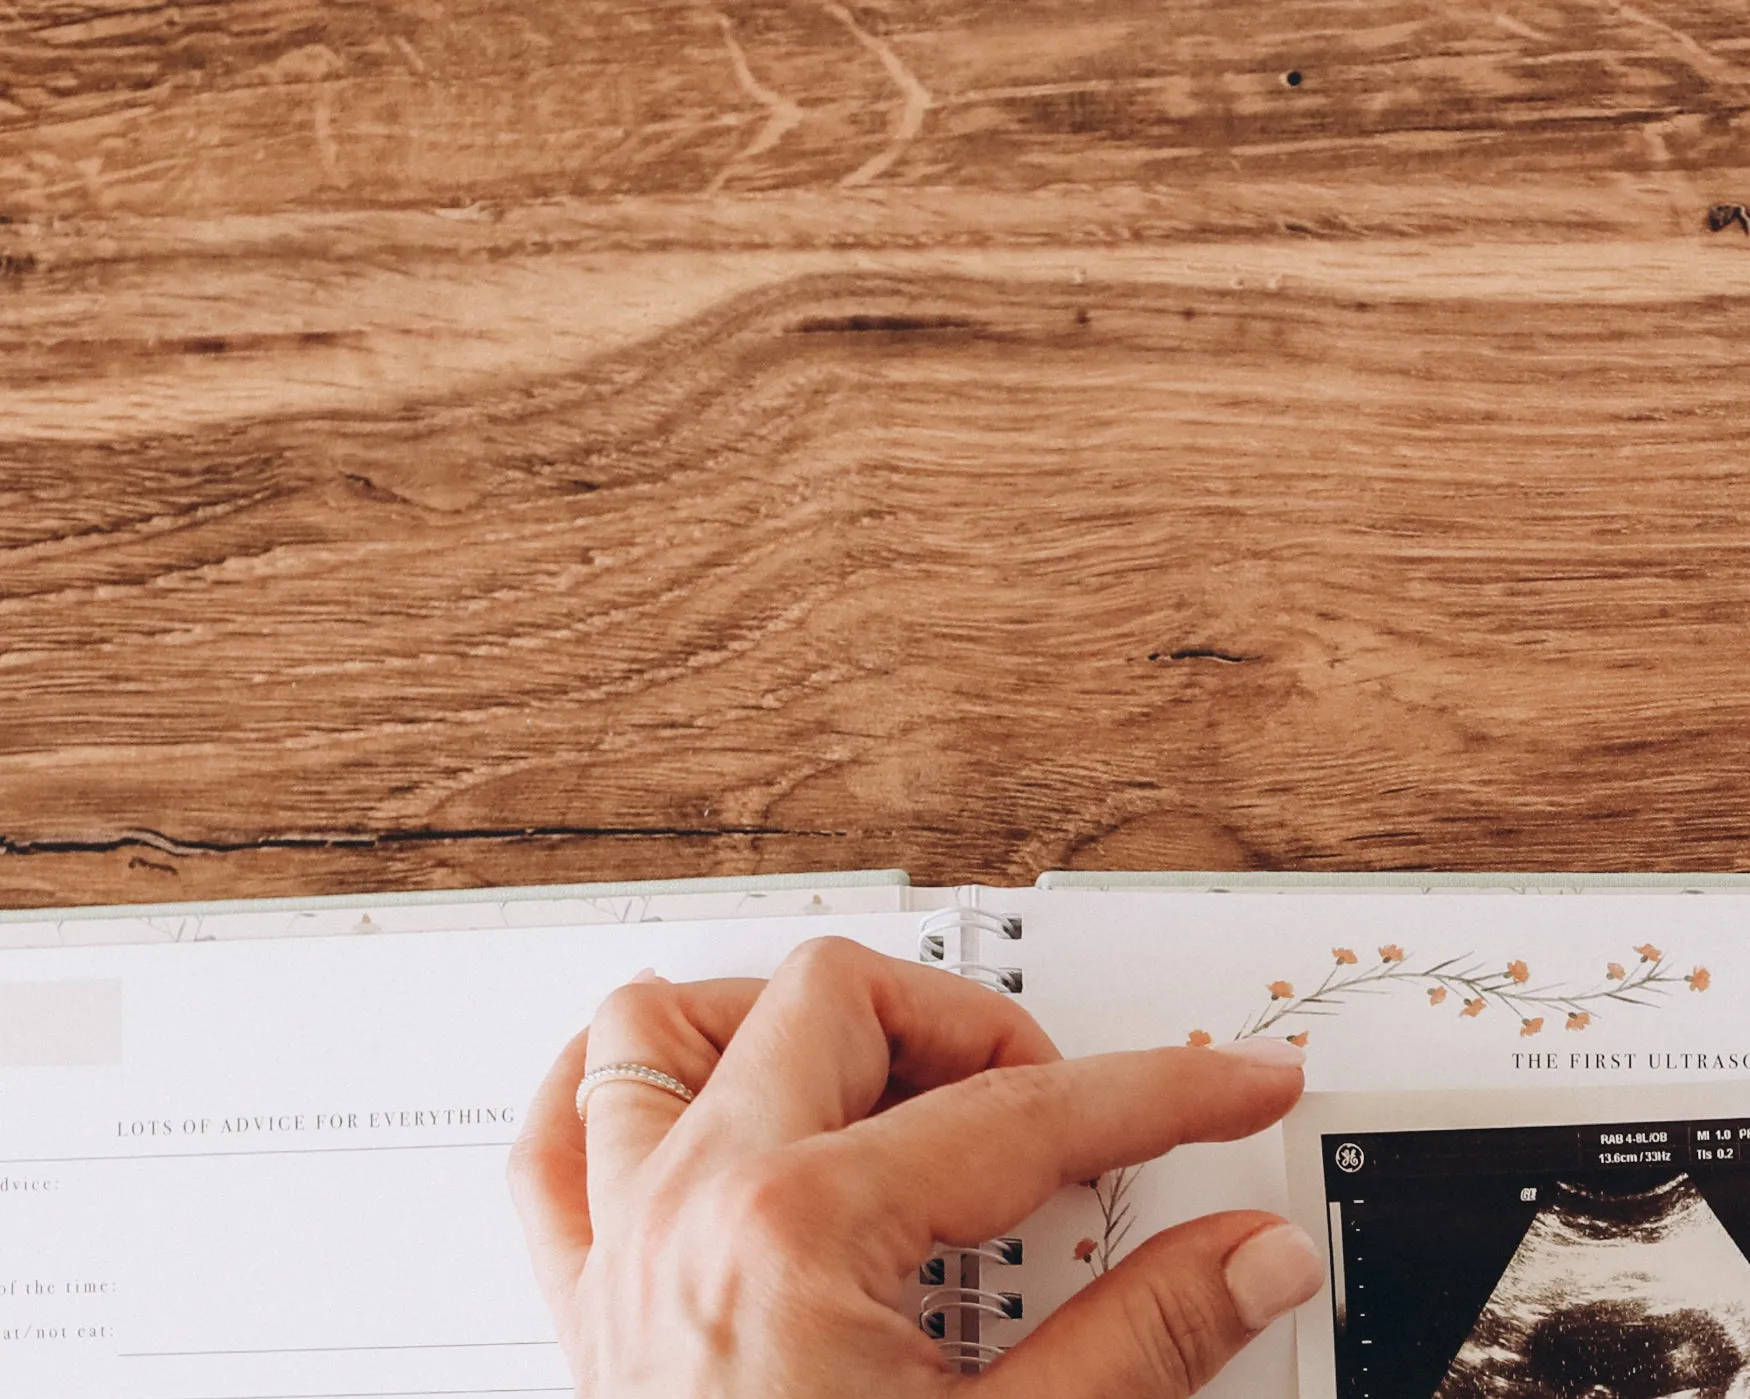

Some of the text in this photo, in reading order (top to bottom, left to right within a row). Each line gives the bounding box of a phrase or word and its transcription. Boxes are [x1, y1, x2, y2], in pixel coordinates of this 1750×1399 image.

[1511, 1053, 1558, 1069] THE
[1569, 1053, 1637, 1069] FIRST
[116, 1107, 517, 1138] LOTS OF ADVICE FOR EVERYTHING
[1600, 1133, 1624, 1145] RAB
[1696, 1129, 1732, 1142] MI 1.0
[1598, 1152, 1639, 1165] 13.6cm
[1645, 1150, 1672, 1163] 33Hz
[1716, 1148, 1734, 1160] 0.2
[0, 1176, 60, 1192] dvice:
[0, 1279, 118, 1296] of the time:
[3, 1325, 115, 1341] at/not eat:
